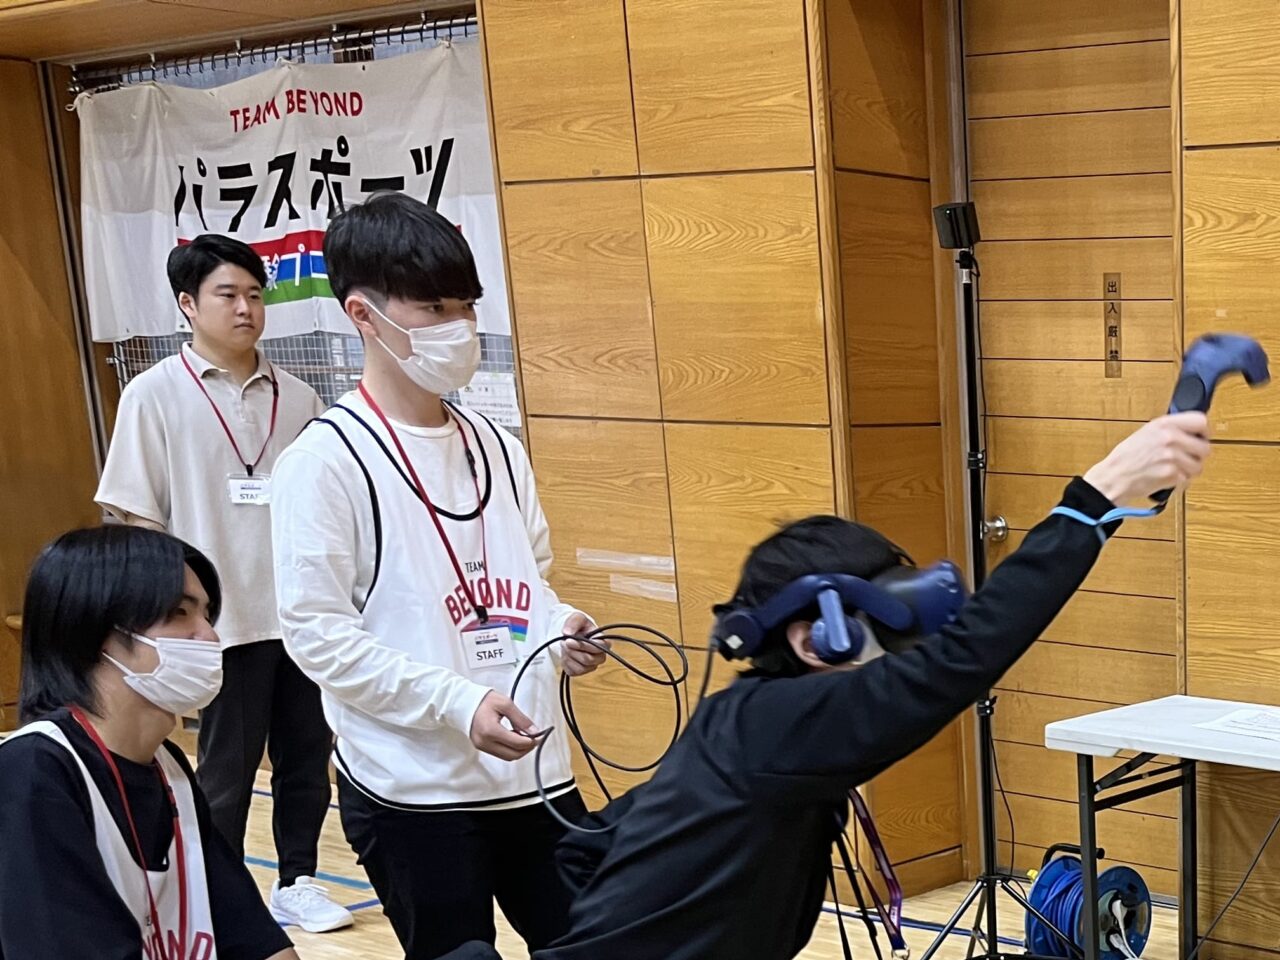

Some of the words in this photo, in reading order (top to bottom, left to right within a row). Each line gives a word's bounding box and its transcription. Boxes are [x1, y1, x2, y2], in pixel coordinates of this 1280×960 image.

[230, 96, 280, 132] TEAM
[285, 89, 363, 117] BEYOND
[174, 135, 454, 232] パラスポーツ
[465, 560, 486, 573] TEAM
[476, 648, 504, 661] STAFF
